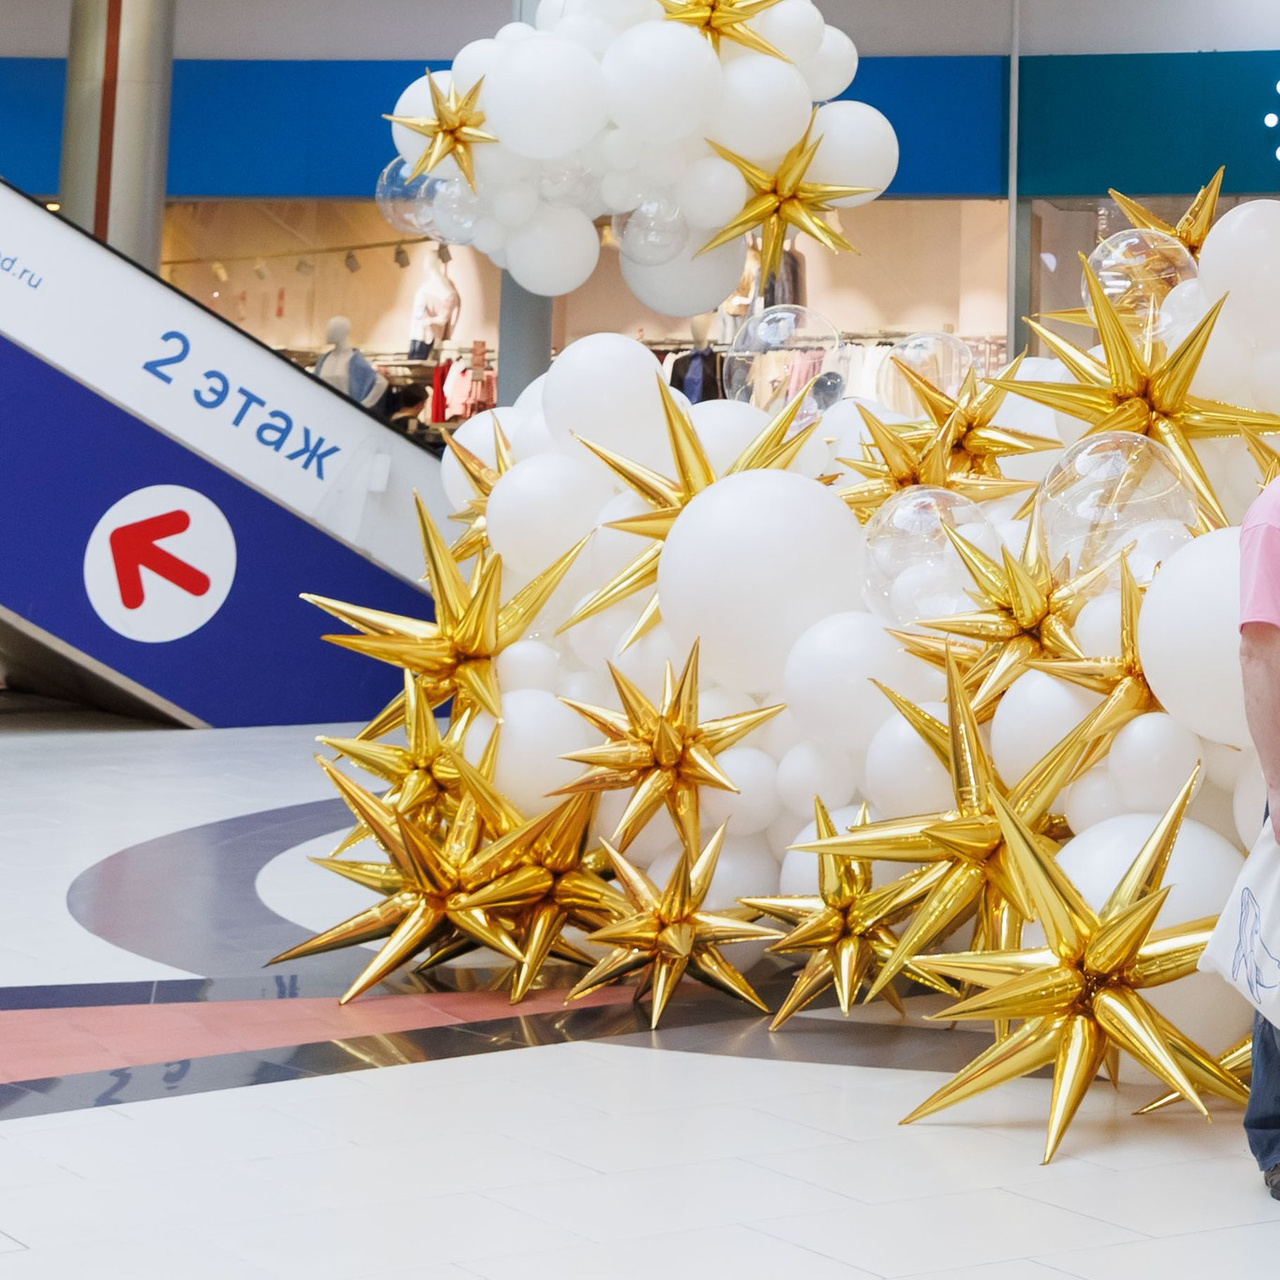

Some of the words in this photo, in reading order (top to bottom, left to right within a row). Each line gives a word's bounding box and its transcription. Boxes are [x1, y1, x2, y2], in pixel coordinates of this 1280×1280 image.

[0, 254, 43, 289] d.ru
[143, 331, 190, 384] 2
[193, 370, 341, 481] этаж
